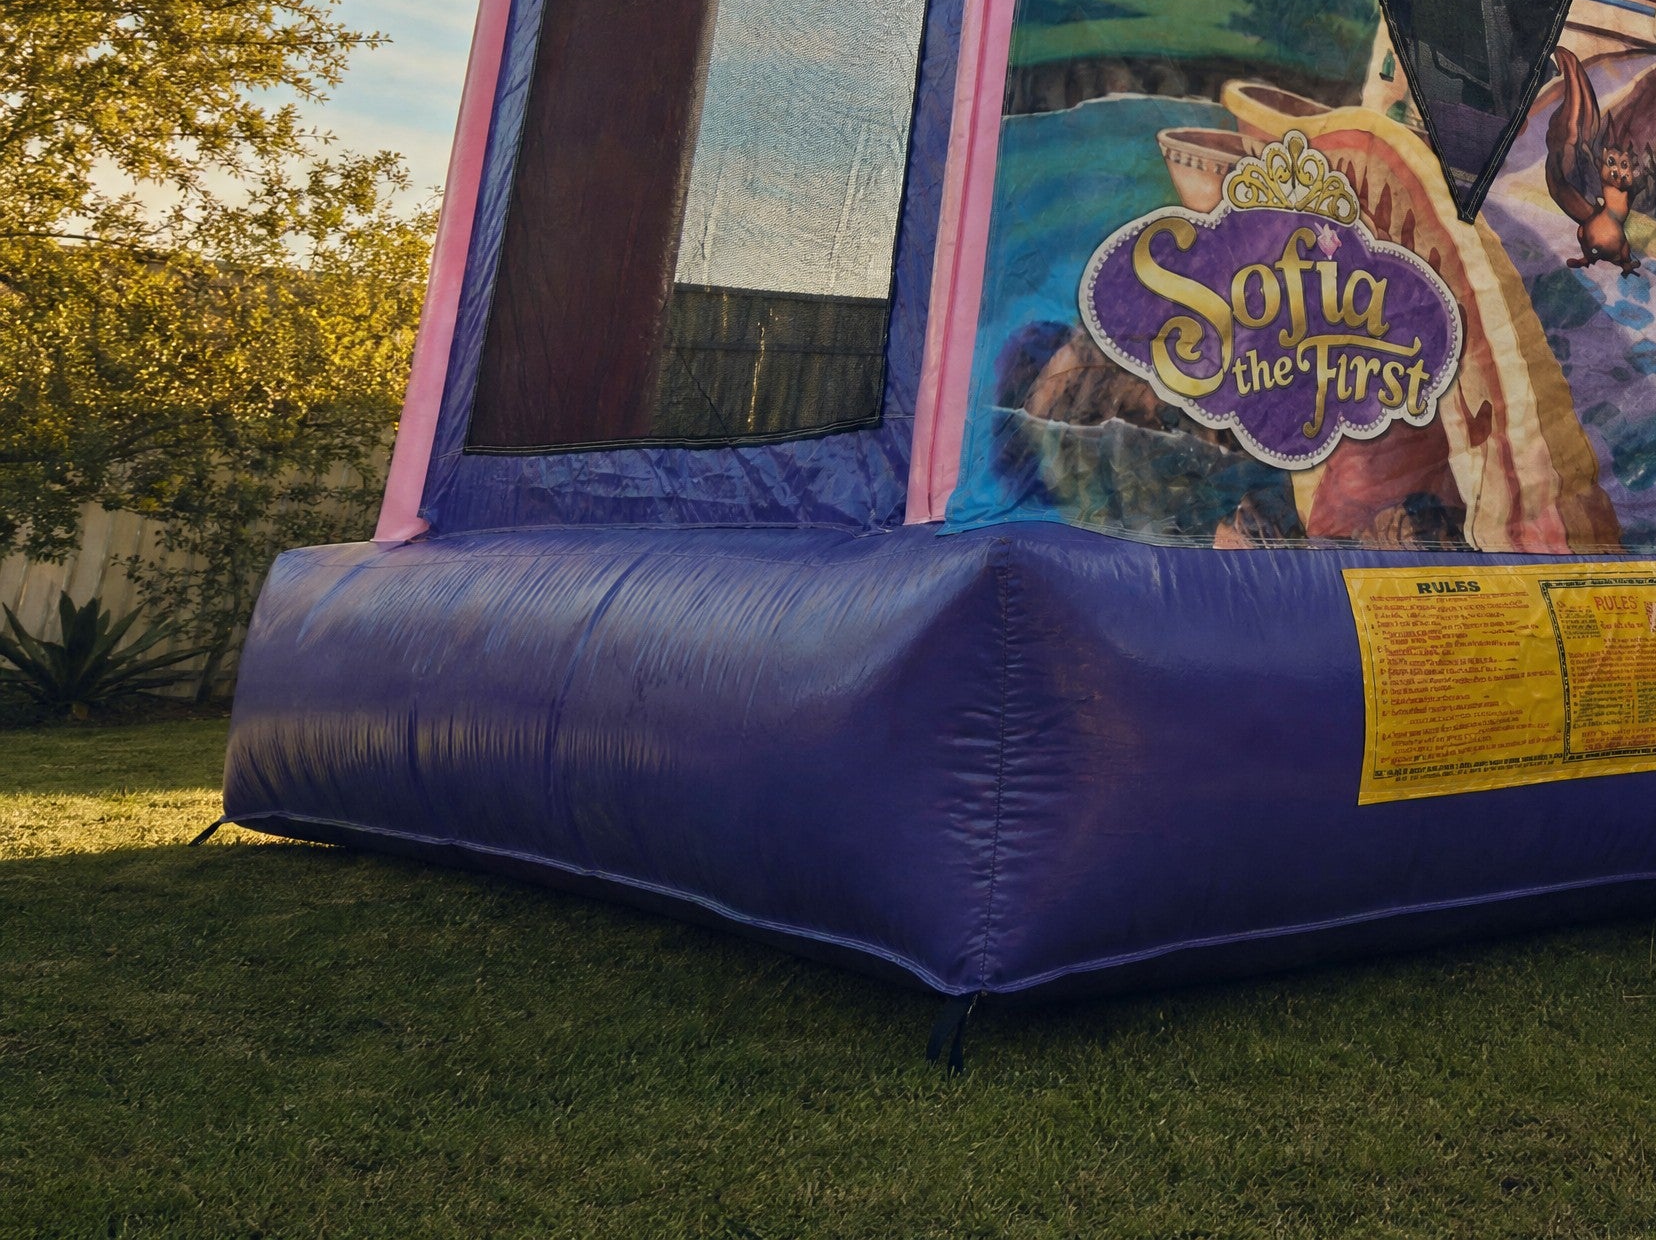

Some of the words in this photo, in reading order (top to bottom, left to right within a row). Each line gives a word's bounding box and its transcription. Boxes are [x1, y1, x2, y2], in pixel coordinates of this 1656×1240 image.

[1133, 218, 1389, 396] Sofia
[1232, 350, 1294, 395] the
[1298, 335, 1429, 437] First
[1417, 580, 1481, 594] RULES
[1594, 596, 1638, 612] RULES
